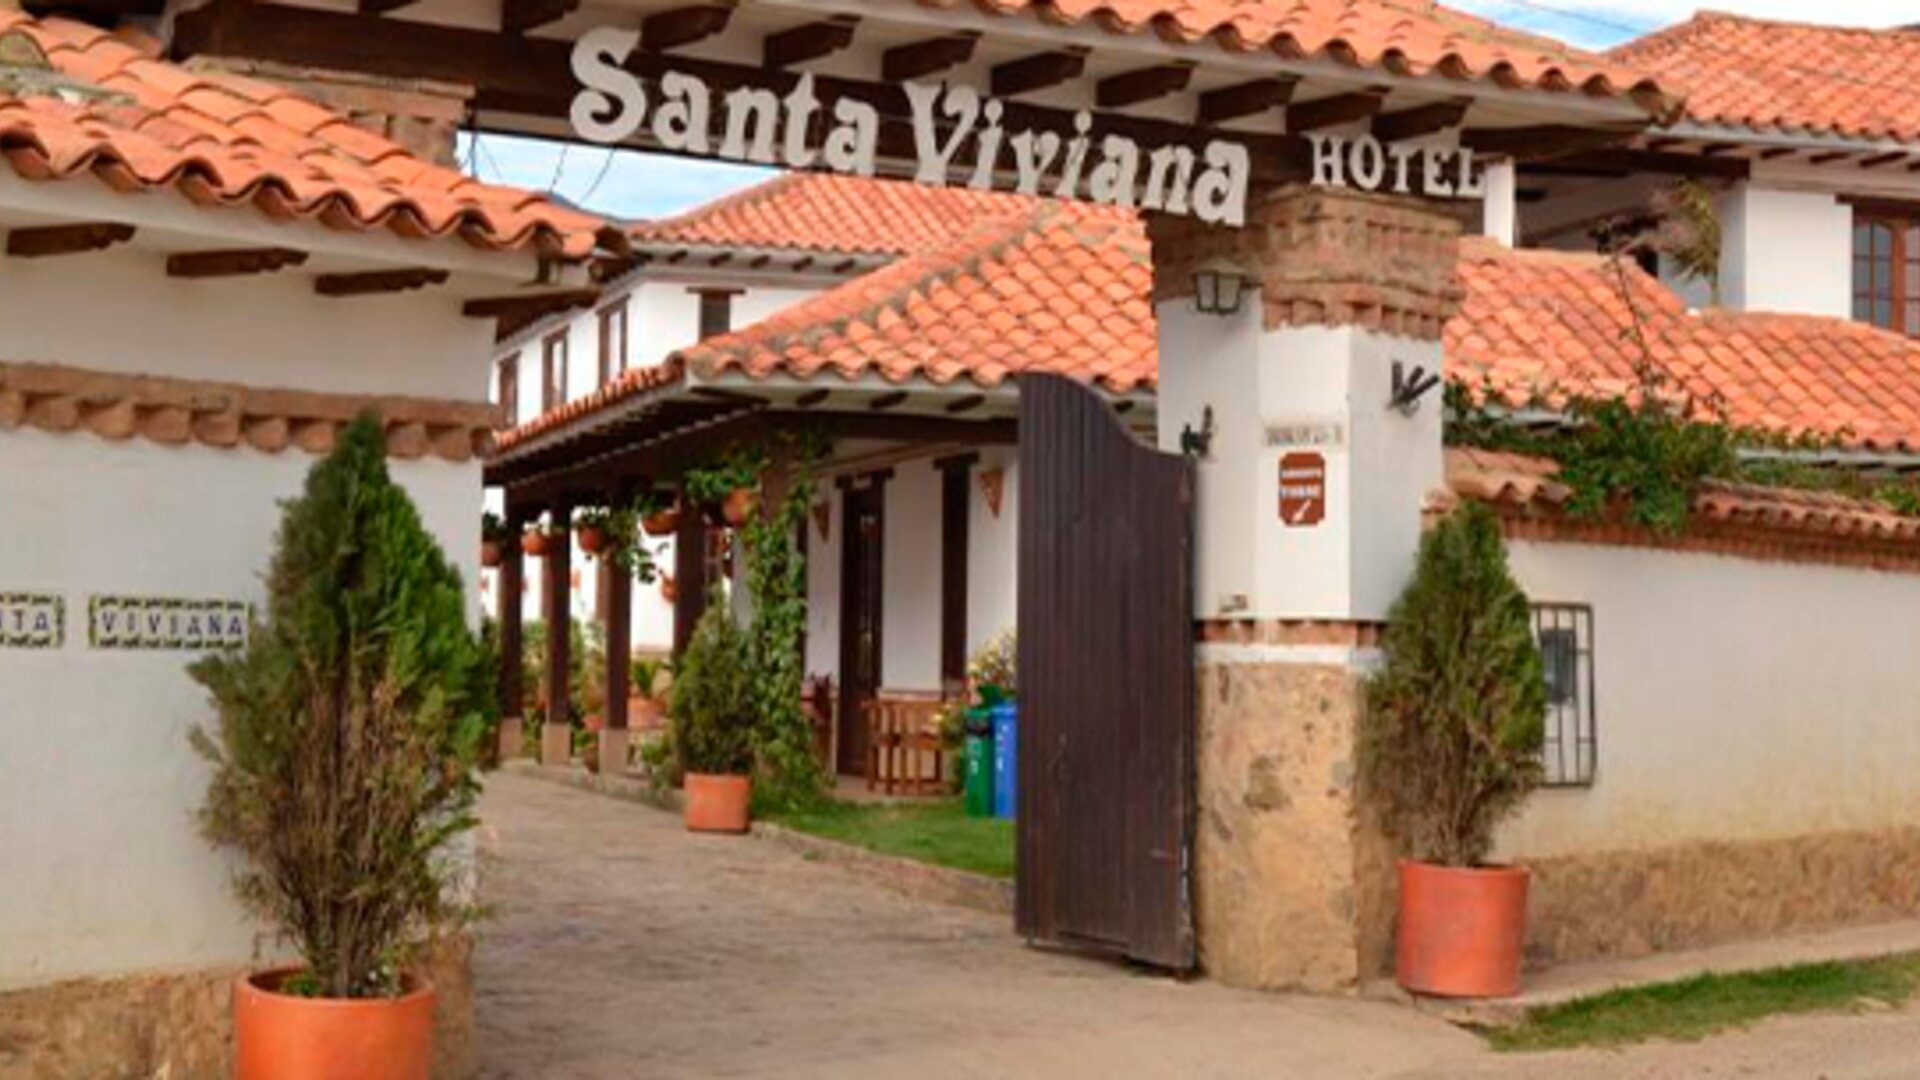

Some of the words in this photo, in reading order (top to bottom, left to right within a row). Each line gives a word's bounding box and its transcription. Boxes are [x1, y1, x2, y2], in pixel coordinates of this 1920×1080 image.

[570, 27, 879, 176] Santa
[902, 80, 1249, 228] Viviana
[1301, 129, 1486, 197] HOTEL
[0, 607, 50, 632] TA
[101, 611, 243, 637] VIVIANA
